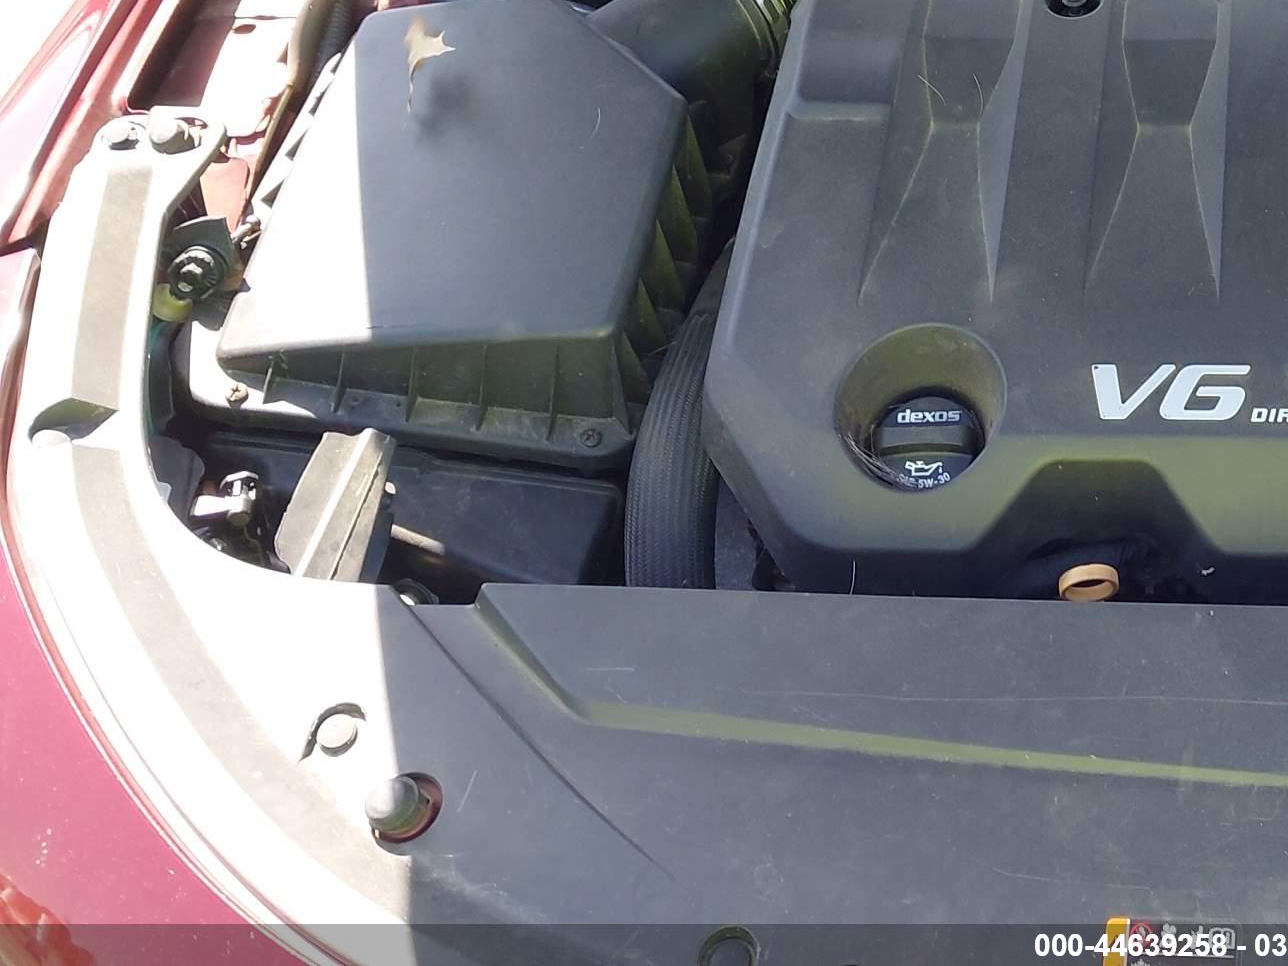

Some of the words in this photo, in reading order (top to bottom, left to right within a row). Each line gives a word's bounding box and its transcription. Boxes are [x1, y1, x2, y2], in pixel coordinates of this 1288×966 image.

[1092, 364, 1251, 420] V6
[896, 408, 961, 424] dexos
[917, 472, 951, 489] 5W-30
